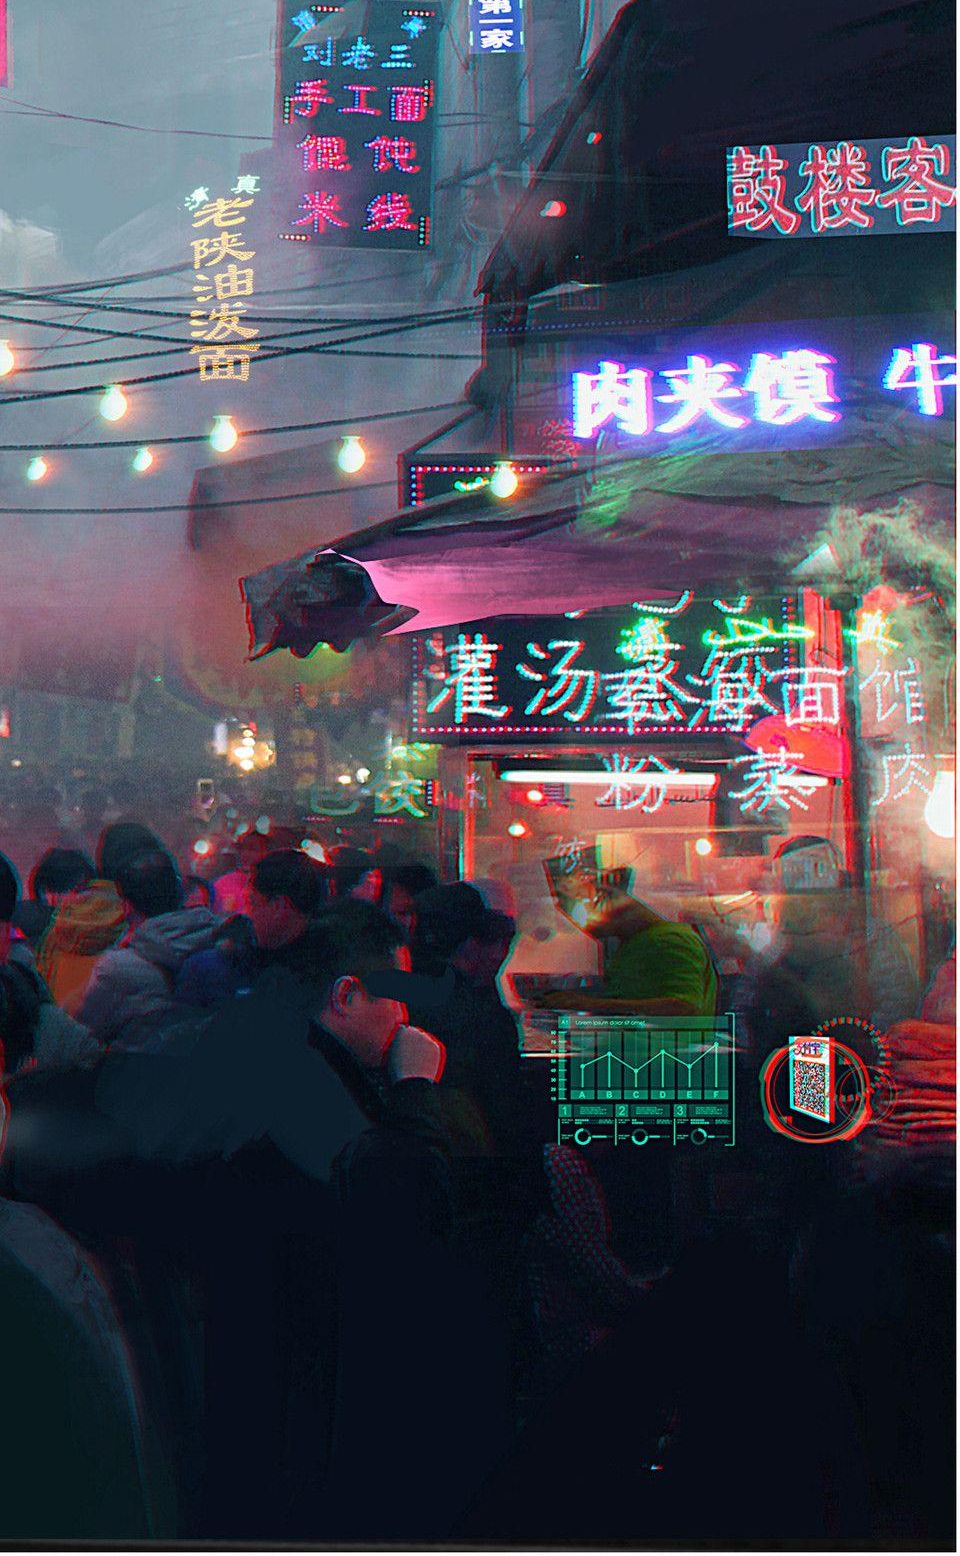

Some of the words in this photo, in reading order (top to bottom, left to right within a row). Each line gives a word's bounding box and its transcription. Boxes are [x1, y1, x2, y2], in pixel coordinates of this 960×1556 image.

[290, 78, 427, 123] 手工面
[727, 136, 957, 235] 鼓楼客
[189, 196, 262, 382] 老陕油泼面
[571, 347, 841, 440] 肉夹馍
[882, 342, 957, 416] 牛
[562, 1106, 567, 1115] 1
[618, 1106, 626, 1115] 2
[676, 1106, 684, 1115] 3
